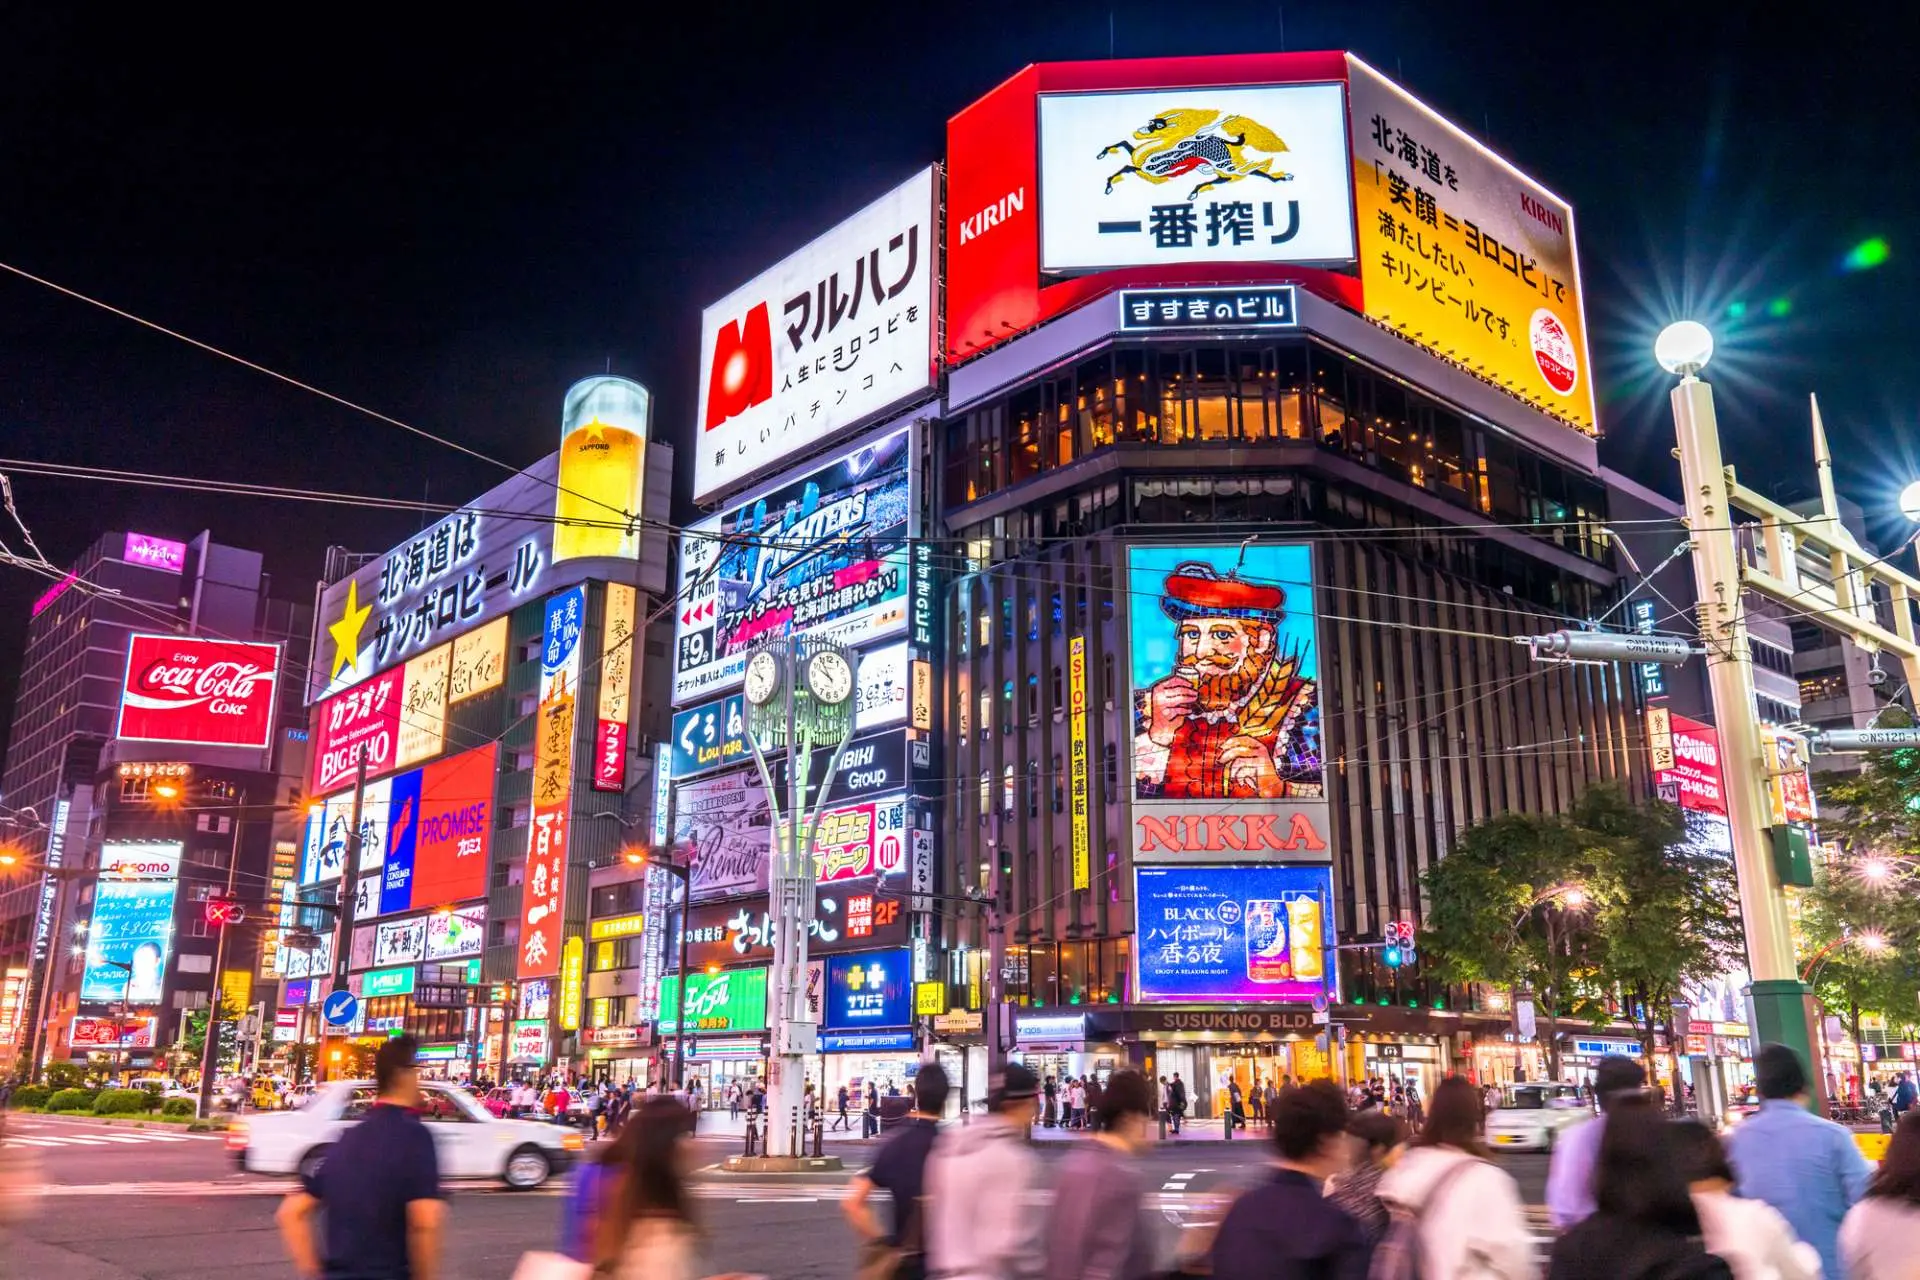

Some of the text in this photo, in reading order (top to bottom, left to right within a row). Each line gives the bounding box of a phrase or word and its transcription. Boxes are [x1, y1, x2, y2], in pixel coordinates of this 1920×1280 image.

[1371, 114, 1458, 192] 北海道を
[959, 187, 1025, 245] KIRIN
[1098, 200, 1300, 248] 一番搾り
[1520, 192, 1563, 236] KIRIN
[1378, 208, 1474, 287] 満たしたい、
[784, 224, 918, 353] マルハン
[1131, 297, 1284, 321] すすきのビル
[1382, 250, 1517, 348] キリンビールです。
[781, 305, 918, 393] 人生にヨロコビを
[715, 362, 903, 467] 新しいパチンコへ
[580, 443, 609, 452] SAPPORO
[380, 511, 479, 603] 北海道は
[695, 552, 708, 563] まで
[748, 489, 868, 598] FIGHTERS
[374, 543, 541, 663] サッポロビール
[725, 574, 835, 631] ファイターズを見ずに
[173, 652, 199, 664] Enjoy
[547, 609, 564, 663] 革命
[1636, 603, 1662, 693] すすビル
[138, 657, 260, 699] Coca-Cola
[1073, 659, 1083, 736] STOP!
[209, 698, 248, 715] Coke
[329, 681, 393, 732] カラオケ
[320, 748, 349, 786] BIG
[604, 723, 620, 777] カラオケ
[831, 746, 875, 770] IBIKI
[850, 769, 886, 789] Group
[1074, 739, 1085, 816] 飲酒運転
[421, 803, 485, 846] PROMISE
[1136, 813, 1326, 852] NIKKA
[458, 838, 481, 858] プロミス
[691, 825, 760, 887] Premier
[387, 869, 411, 880] CONSUMER
[875, 900, 898, 925] 2F
[1147, 924, 1234, 942] ハイボール
[1164, 907, 1216, 920] BLACK
[1160, 941, 1224, 964] 香る夜
[137, 1036, 149, 1045] 2F
[1163, 1013, 1313, 1029] SUSUKINO BLD.
